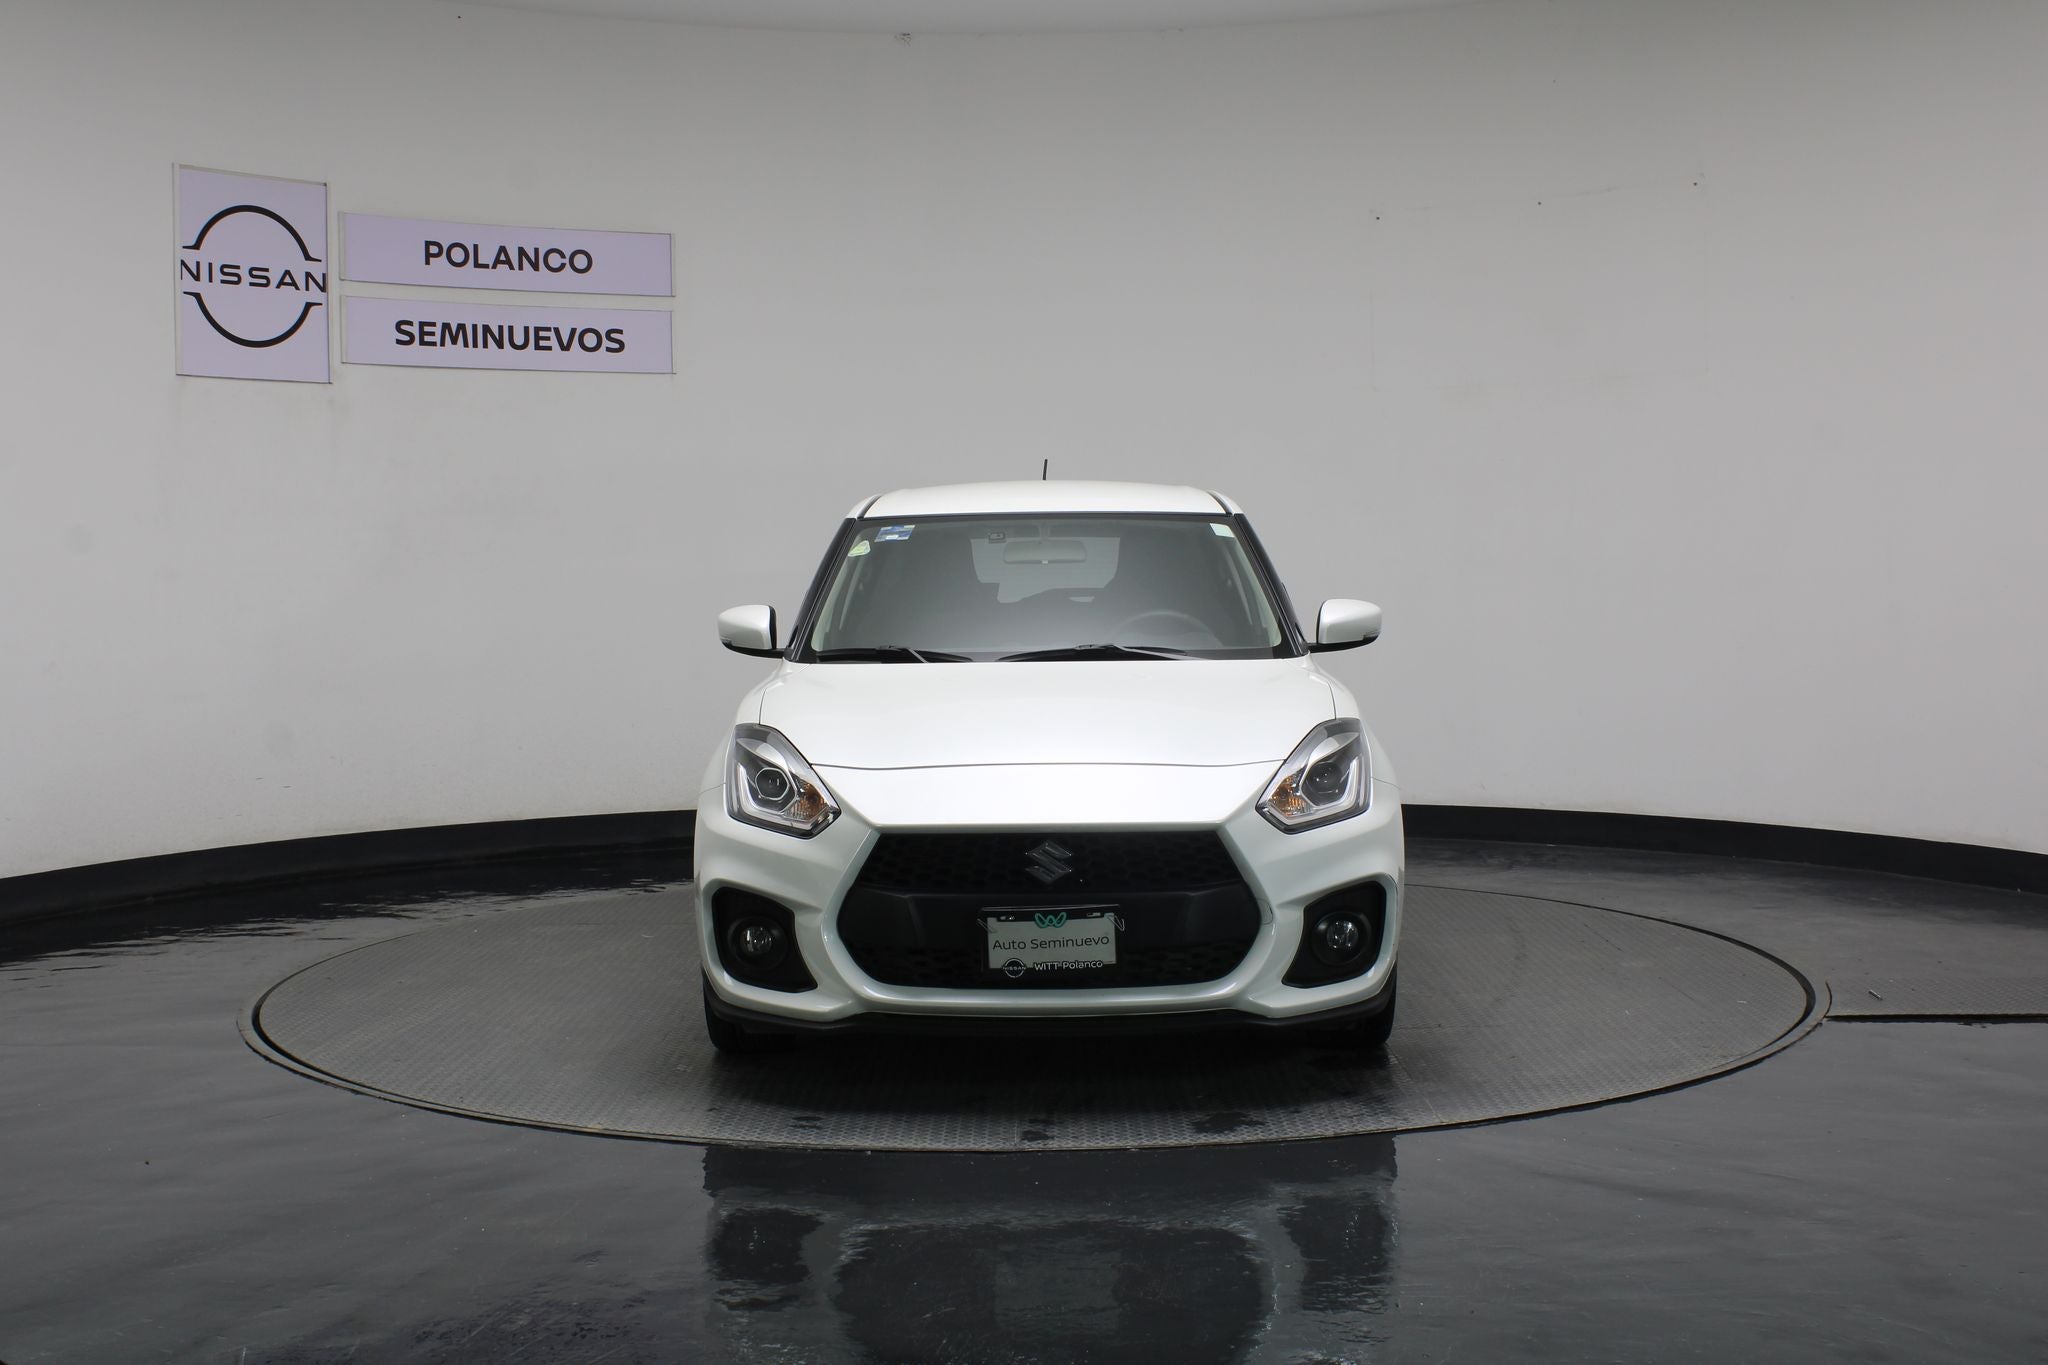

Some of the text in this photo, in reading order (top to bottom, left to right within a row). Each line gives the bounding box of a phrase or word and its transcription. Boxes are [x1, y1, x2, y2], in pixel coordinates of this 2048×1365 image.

[423, 239, 593, 275] POLANCO
[180, 258, 327, 293] NISSAN
[393, 319, 626, 354] SEMINUEVOS
[992, 935, 1110, 950] Auto Seminuevo
[1033, 960, 1103, 971] WITT Polanco
